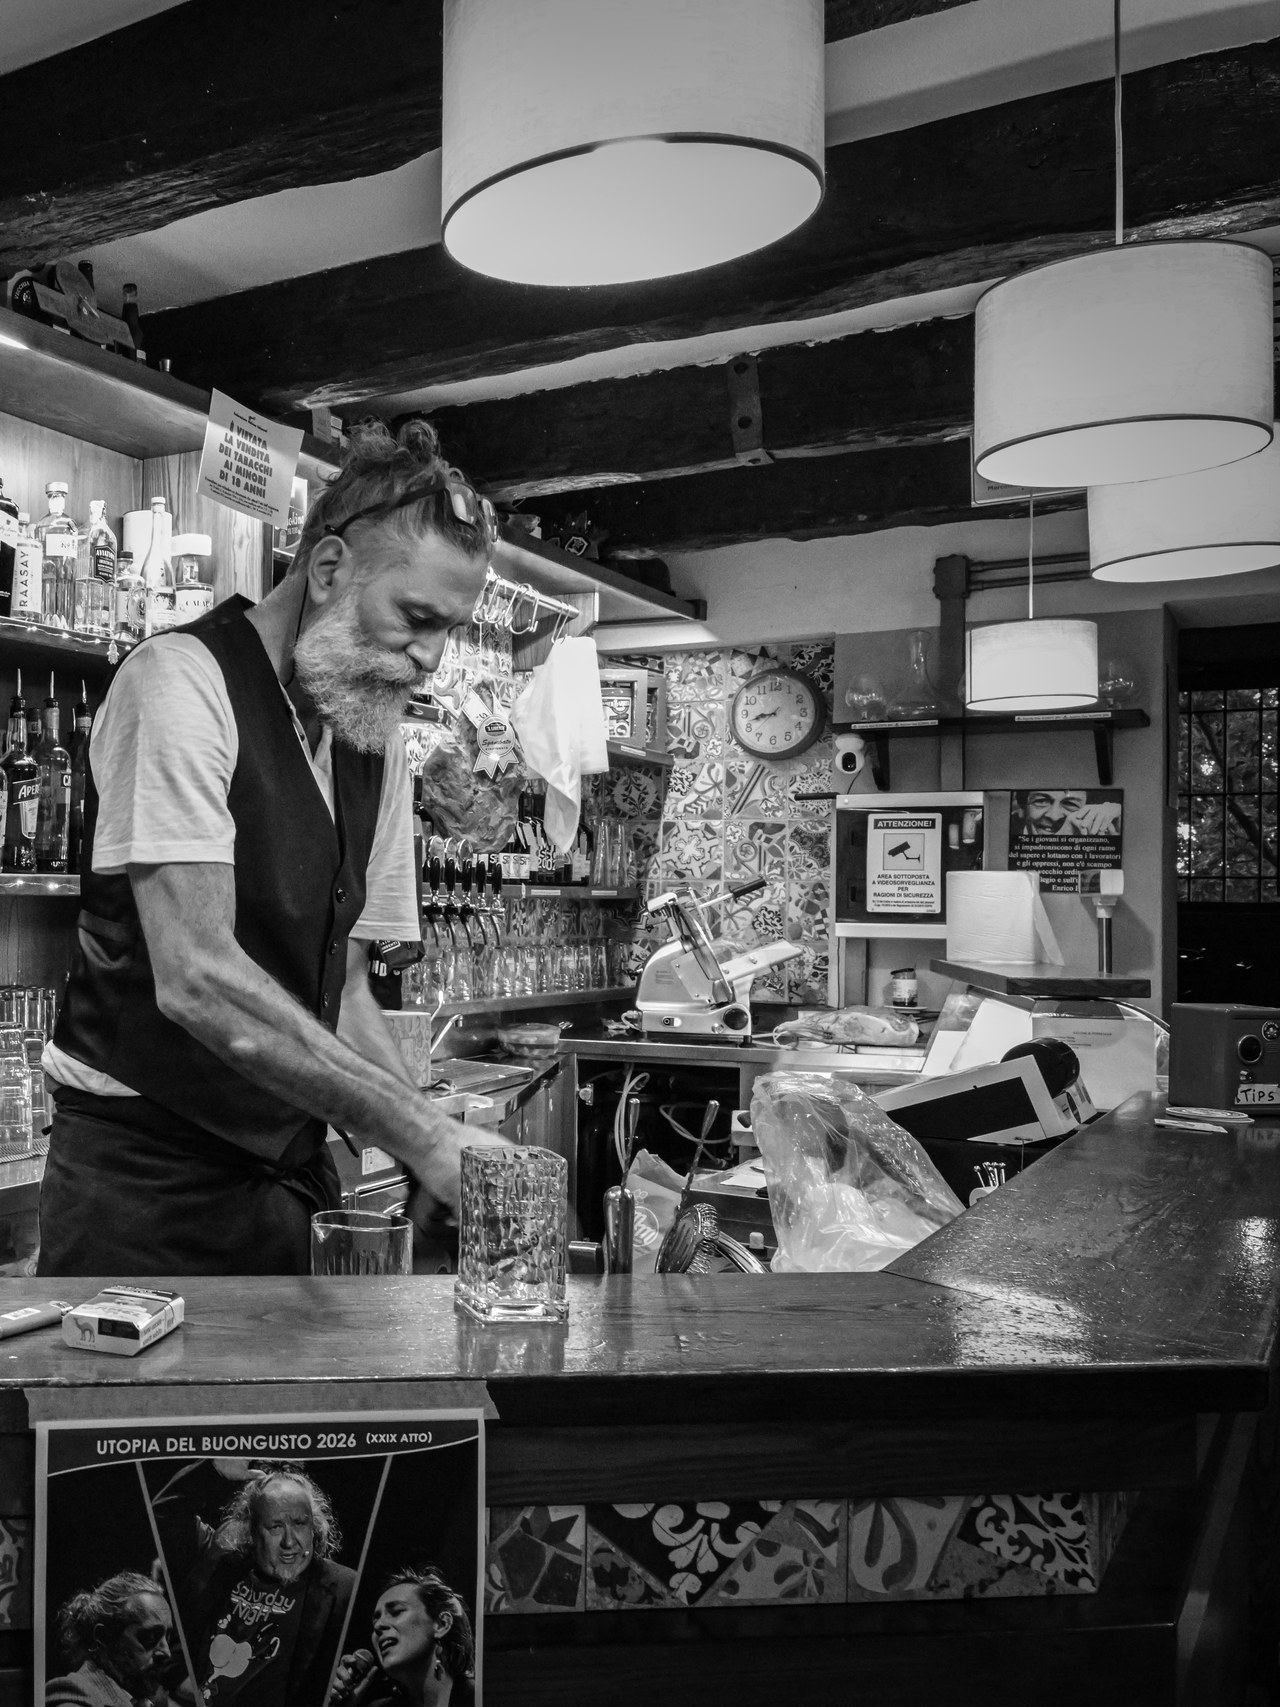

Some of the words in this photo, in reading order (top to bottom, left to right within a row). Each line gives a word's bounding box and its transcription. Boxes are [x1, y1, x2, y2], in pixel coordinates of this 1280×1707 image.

[237, 425, 267, 450] VIETATA
[224, 432, 233, 446] LA
[236, 438, 270, 464] VENDITA
[219, 443, 232, 458] DEI
[234, 450, 273, 477] TABACCHI
[224, 459, 233, 471] AI
[235, 465, 267, 487] MINORI
[219, 469, 229, 482] DI
[232, 475, 241, 488] 18
[243, 481, 266, 499] ANNI
[19, 550, 29, 607] RAASAY
[757, 685, 767, 695] 11
[786, 685, 792, 694] 1
[744, 695, 757, 706] 10
[795, 694, 803, 704] 2
[741, 709, 749, 719] 9
[799, 707, 808, 718] 3
[745, 722, 752, 733] 8
[794, 721, 802, 731] 4
[755, 732, 762, 742] 7
[769, 735, 777, 745] 6
[784, 731, 792, 741] 5
[18, 784, 40, 799] APER
[877, 820, 932, 828] ATTENZIONE!
[1021, 844, 1073, 852] impadroniscono
[97, 1438, 160, 1454] UTOPIA
[166, 1437, 196, 1452] DEL
[201, 1434, 312, 1451] BUONGUSTO
[316, 1433, 357, 1449] 2026
[365, 1432, 397, 1445] (XXIX
[400, 1431, 433, 1444] ATTO)
